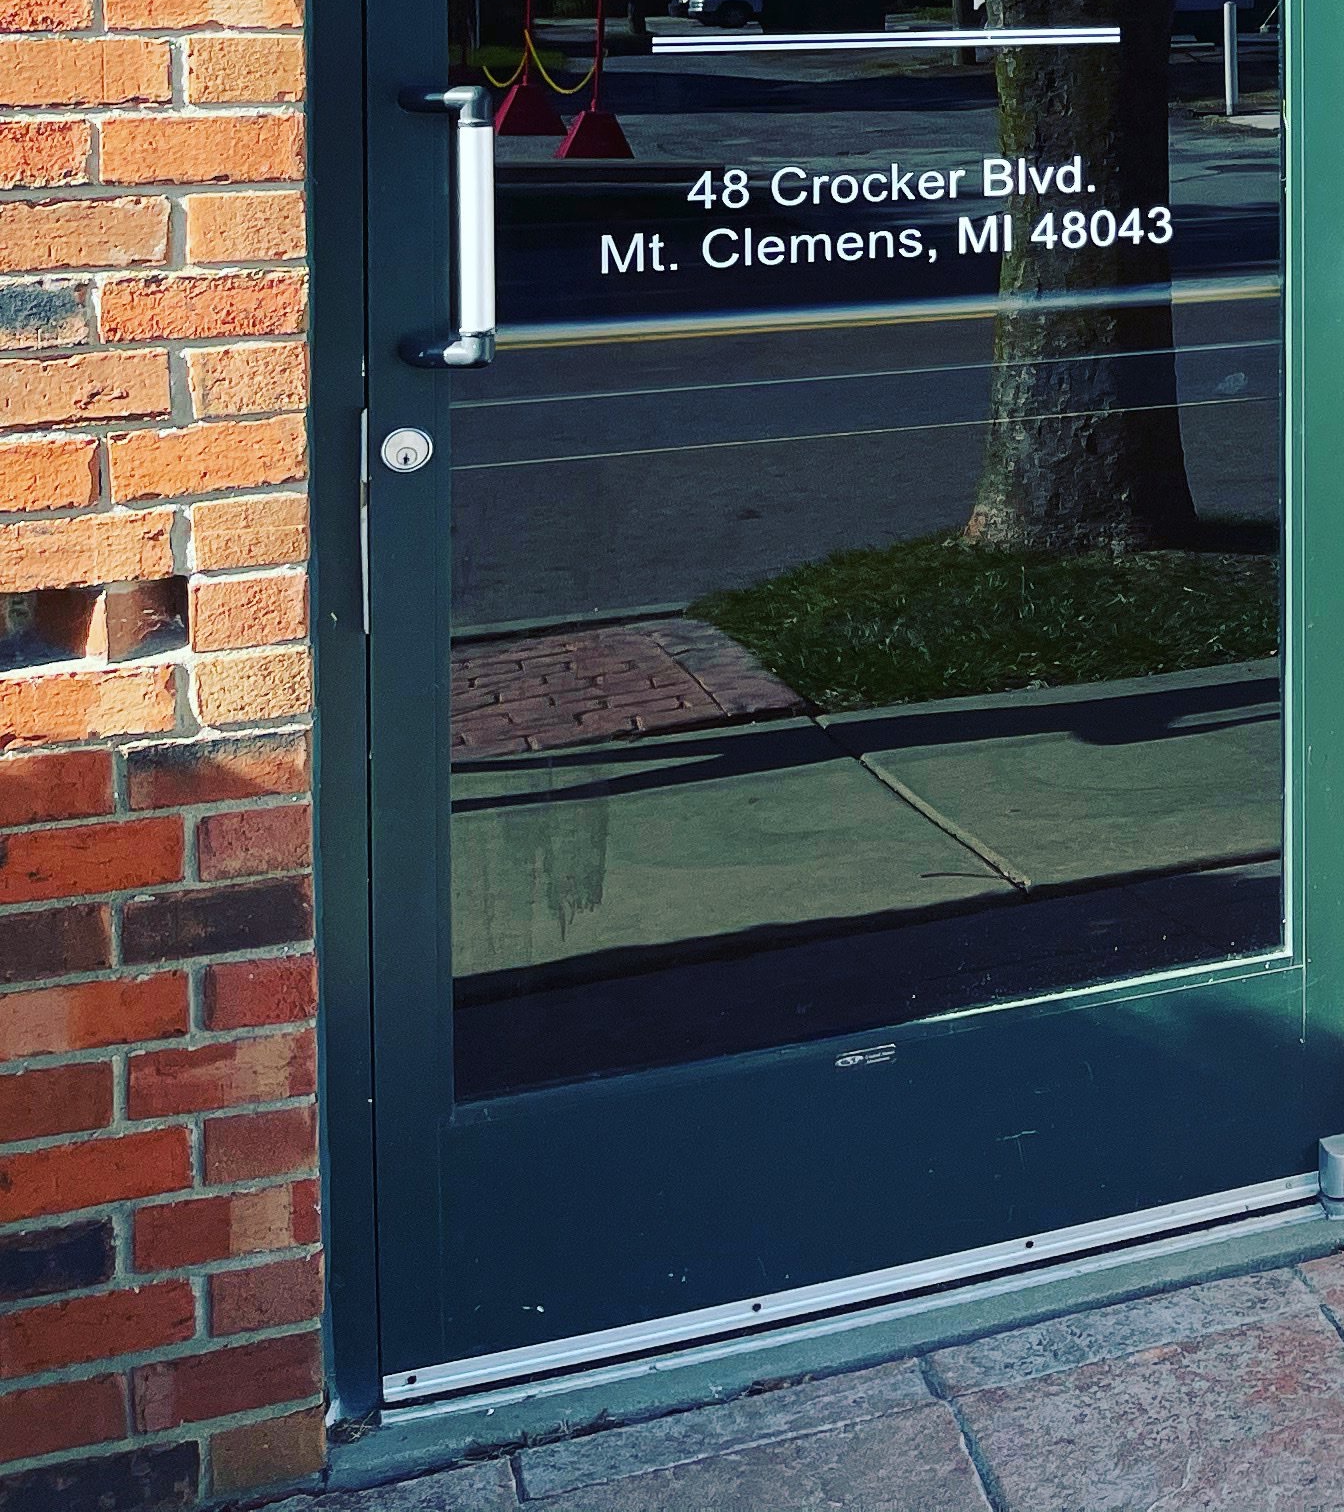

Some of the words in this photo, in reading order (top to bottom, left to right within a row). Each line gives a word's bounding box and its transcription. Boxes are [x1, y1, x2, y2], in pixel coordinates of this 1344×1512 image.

[687, 169, 750, 210] 48
[770, 163, 967, 207] Crocker
[982, 155, 1096, 197] Blvd.
[600, 231, 679, 274] Mt.
[701, 225, 939, 269] Clemens,
[957, 214, 1012, 254] MI
[1029, 206, 1174, 250] 48043
